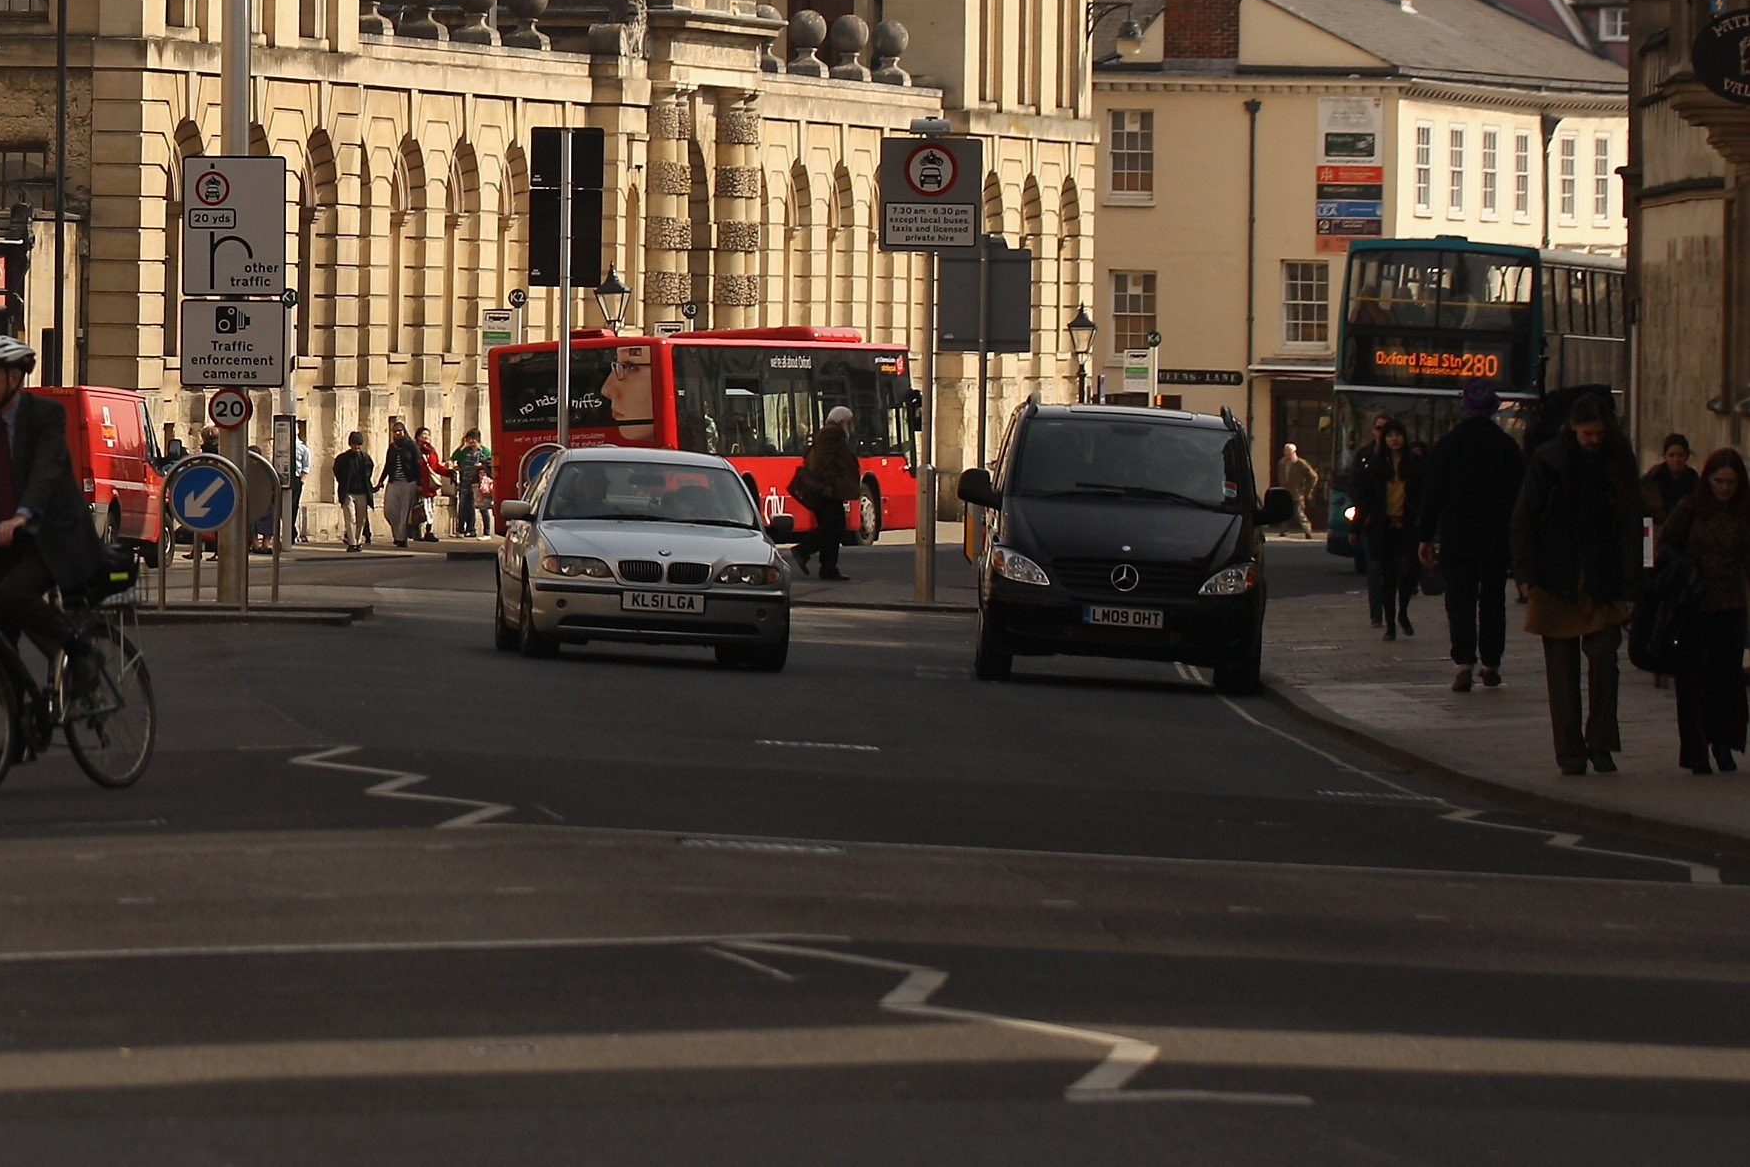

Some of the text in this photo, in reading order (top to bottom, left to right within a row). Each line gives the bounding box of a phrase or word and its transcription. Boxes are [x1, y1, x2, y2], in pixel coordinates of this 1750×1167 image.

[194, 214, 230, 224] 20 yds
[244, 262, 279, 273] other
[231, 276, 271, 286] traffic
[282, 292, 296, 302] K1
[510, 293, 525, 302] K2
[683, 304, 697, 314] K3
[1148, 333, 1160, 343] K4
[211, 340, 254, 351] Traffic
[191, 354, 274, 366] enforcement
[1376, 351, 1498, 377] Oxford Rail Stn 280
[203, 370, 257, 379] cameras
[1159, 373, 1196, 382] UEENS
[1205, 373, 1239, 382] LANE
[519, 392, 602, 415] no nas niffs
[215, 401, 244, 418] 20
[572, 433, 605, 441] particulates
[632, 593, 694, 609] KL51 LGA
[1092, 609, 1160, 625] LM09 OHT
